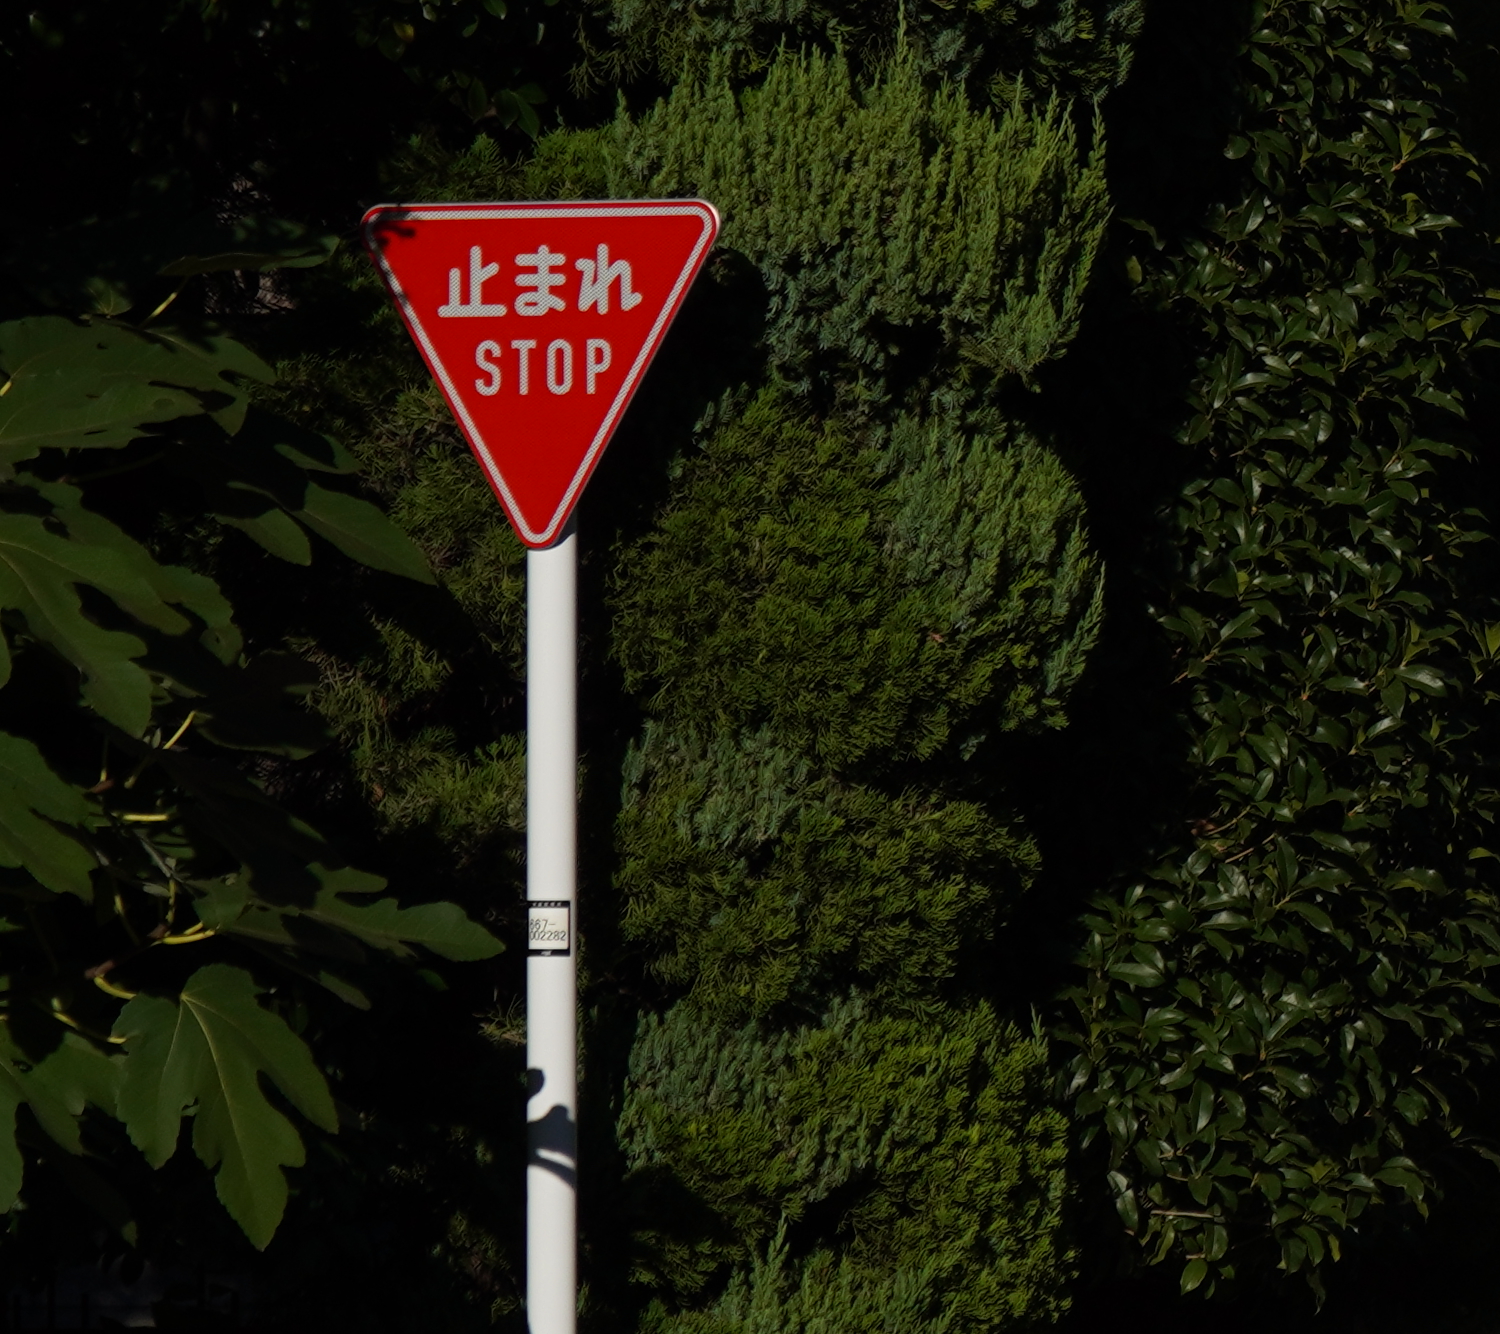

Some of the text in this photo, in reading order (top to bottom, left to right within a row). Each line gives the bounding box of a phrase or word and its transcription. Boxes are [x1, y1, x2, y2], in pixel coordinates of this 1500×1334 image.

[437, 243, 643, 318] 止まれ
[474, 338, 612, 397] STOP
